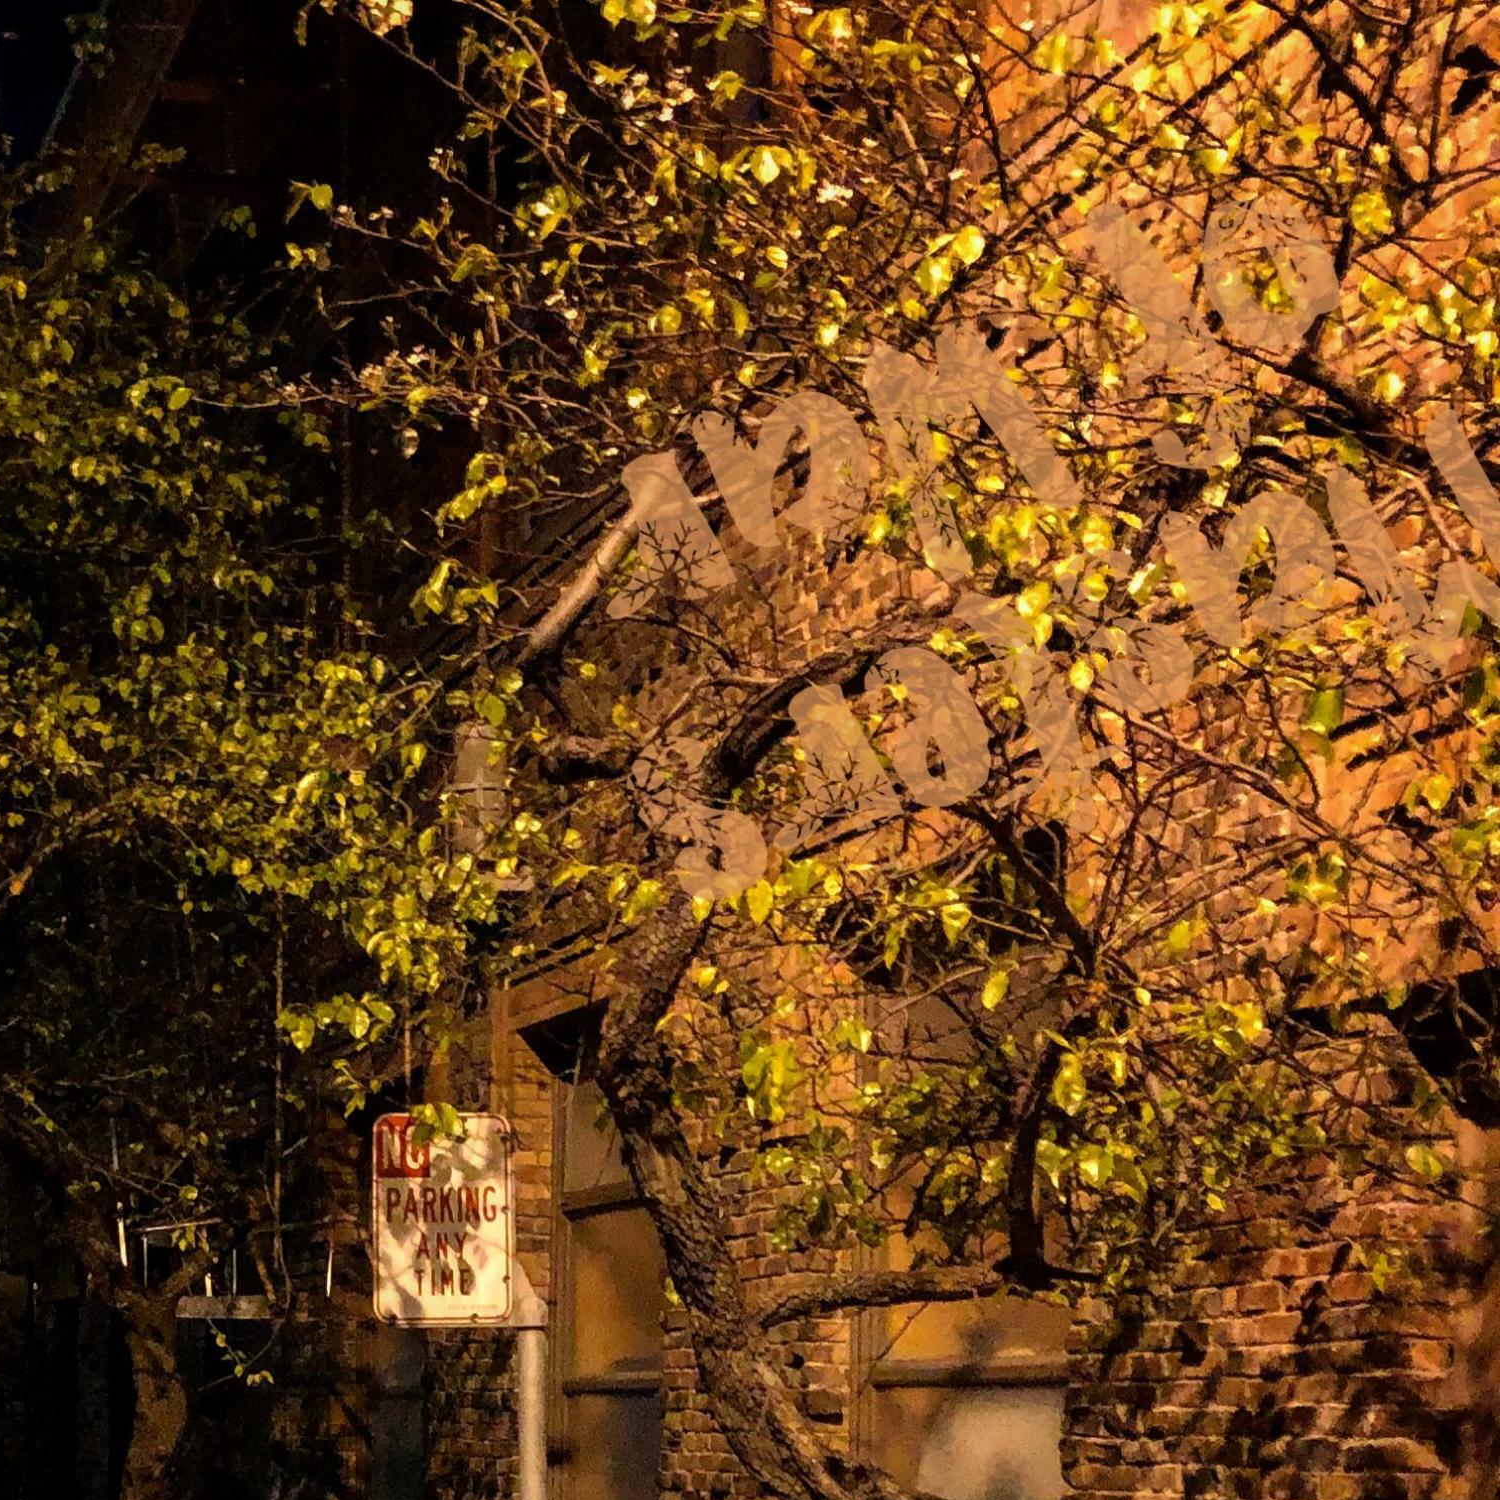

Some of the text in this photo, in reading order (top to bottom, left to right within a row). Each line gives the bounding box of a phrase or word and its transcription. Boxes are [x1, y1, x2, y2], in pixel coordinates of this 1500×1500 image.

[386, 1186, 498, 1223] PARKING
[417, 1232, 467, 1259] ANY
[414, 1268, 473, 1296] TIME
